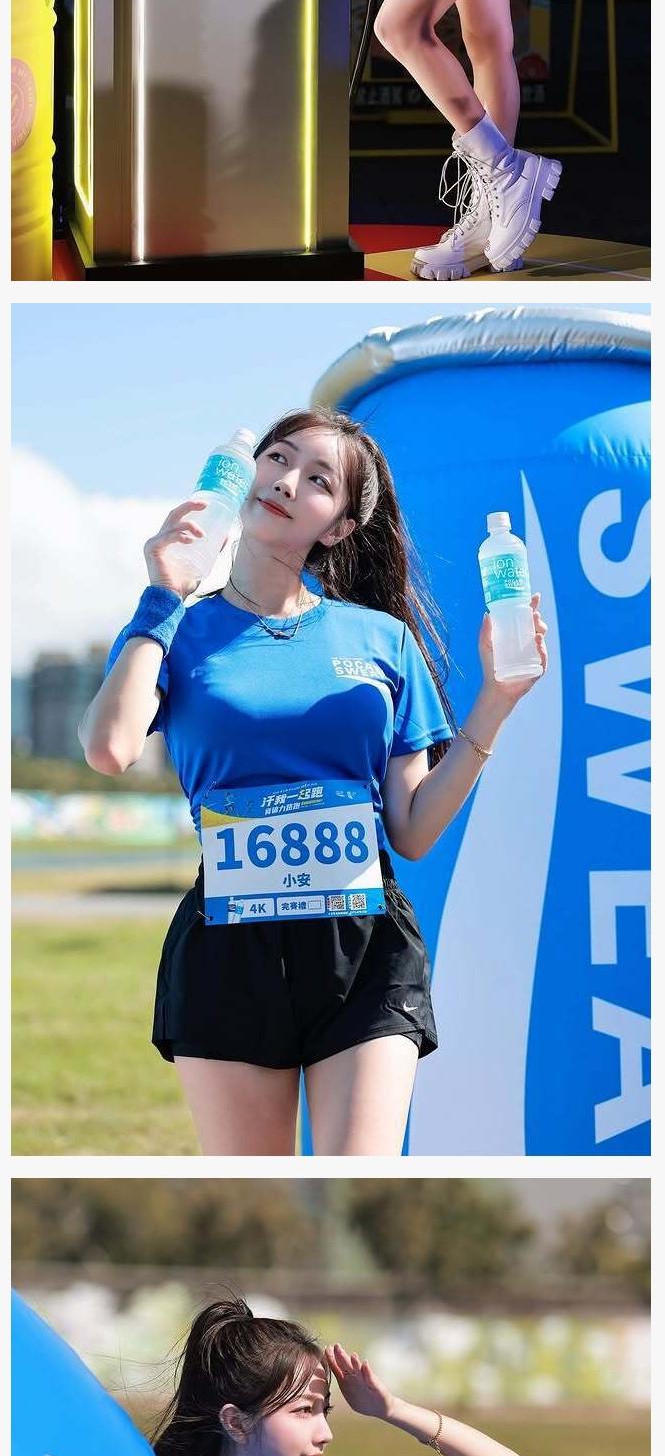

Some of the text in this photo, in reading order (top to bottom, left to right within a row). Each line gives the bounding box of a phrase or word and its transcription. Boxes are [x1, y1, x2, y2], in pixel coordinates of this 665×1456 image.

[493, 557, 514, 569] ion
[217, 821, 369, 870] 16888
[282, 872, 311, 888] 小安
[249, 903, 267, 914] 4K
